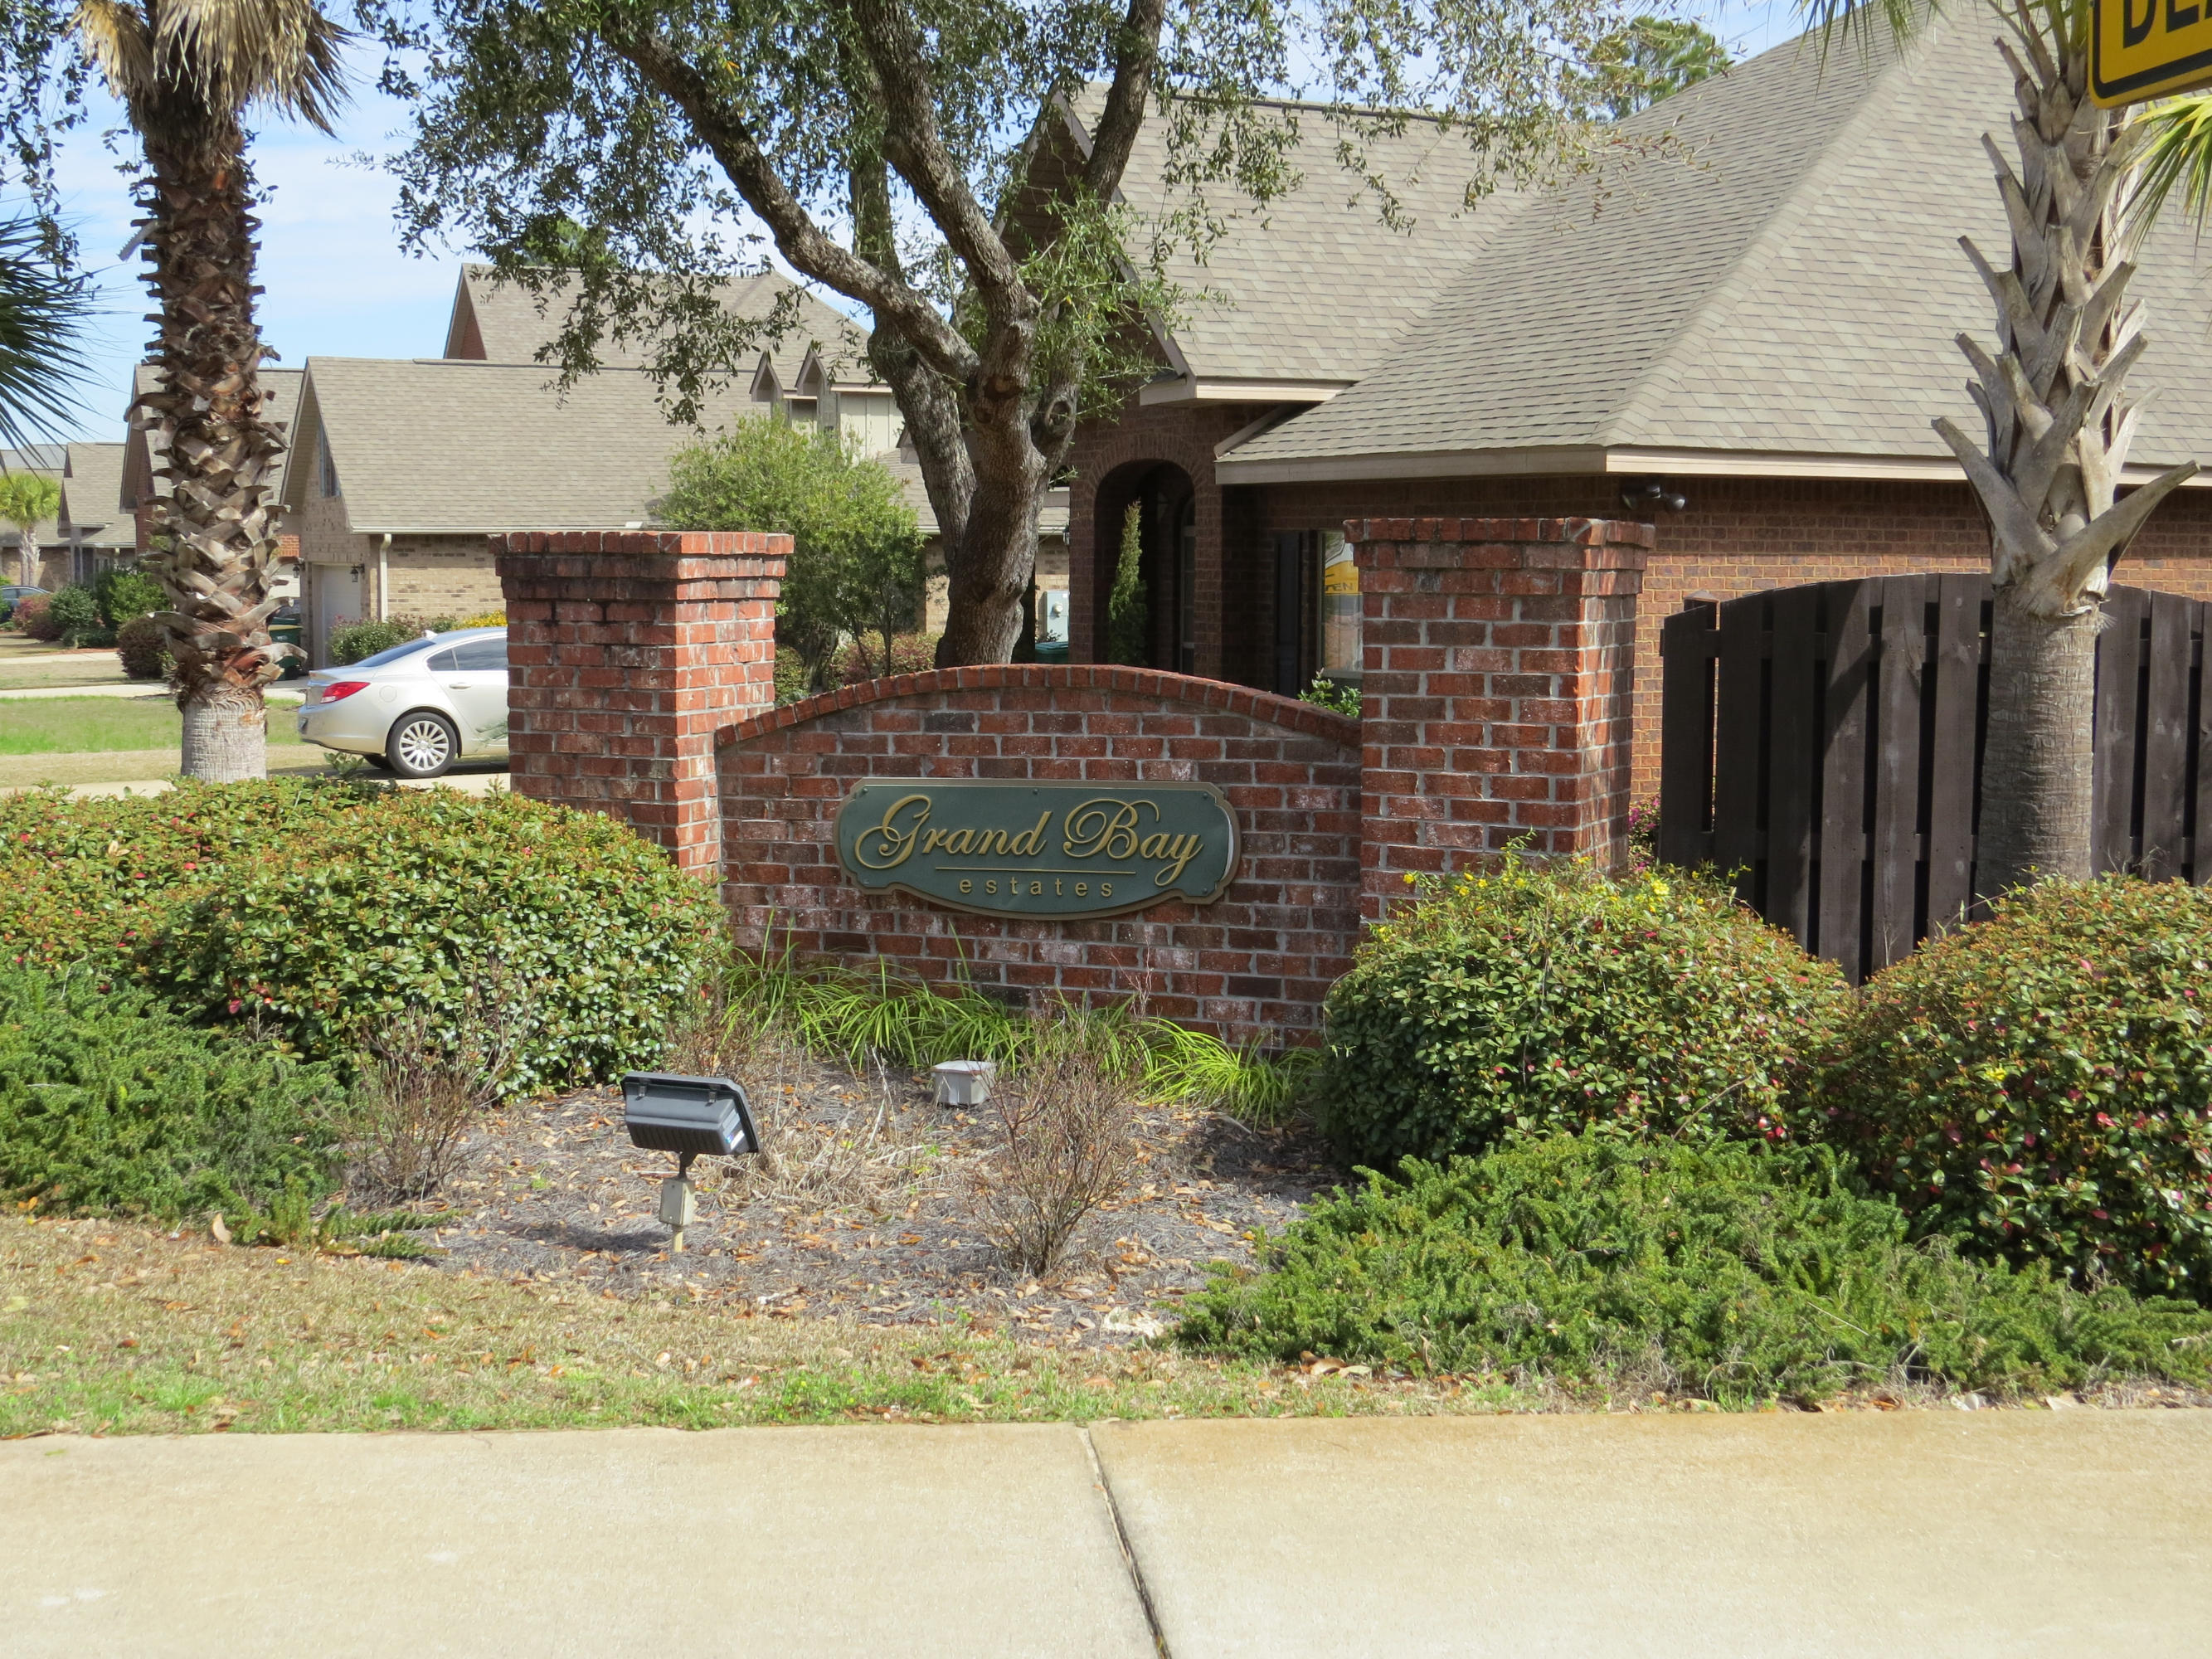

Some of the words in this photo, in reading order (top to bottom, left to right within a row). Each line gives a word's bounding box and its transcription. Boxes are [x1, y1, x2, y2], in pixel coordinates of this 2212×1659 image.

[855, 795, 1053, 868] Grand
[1062, 798, 1204, 886] Bay
[959, 876, 1114, 898] estates
